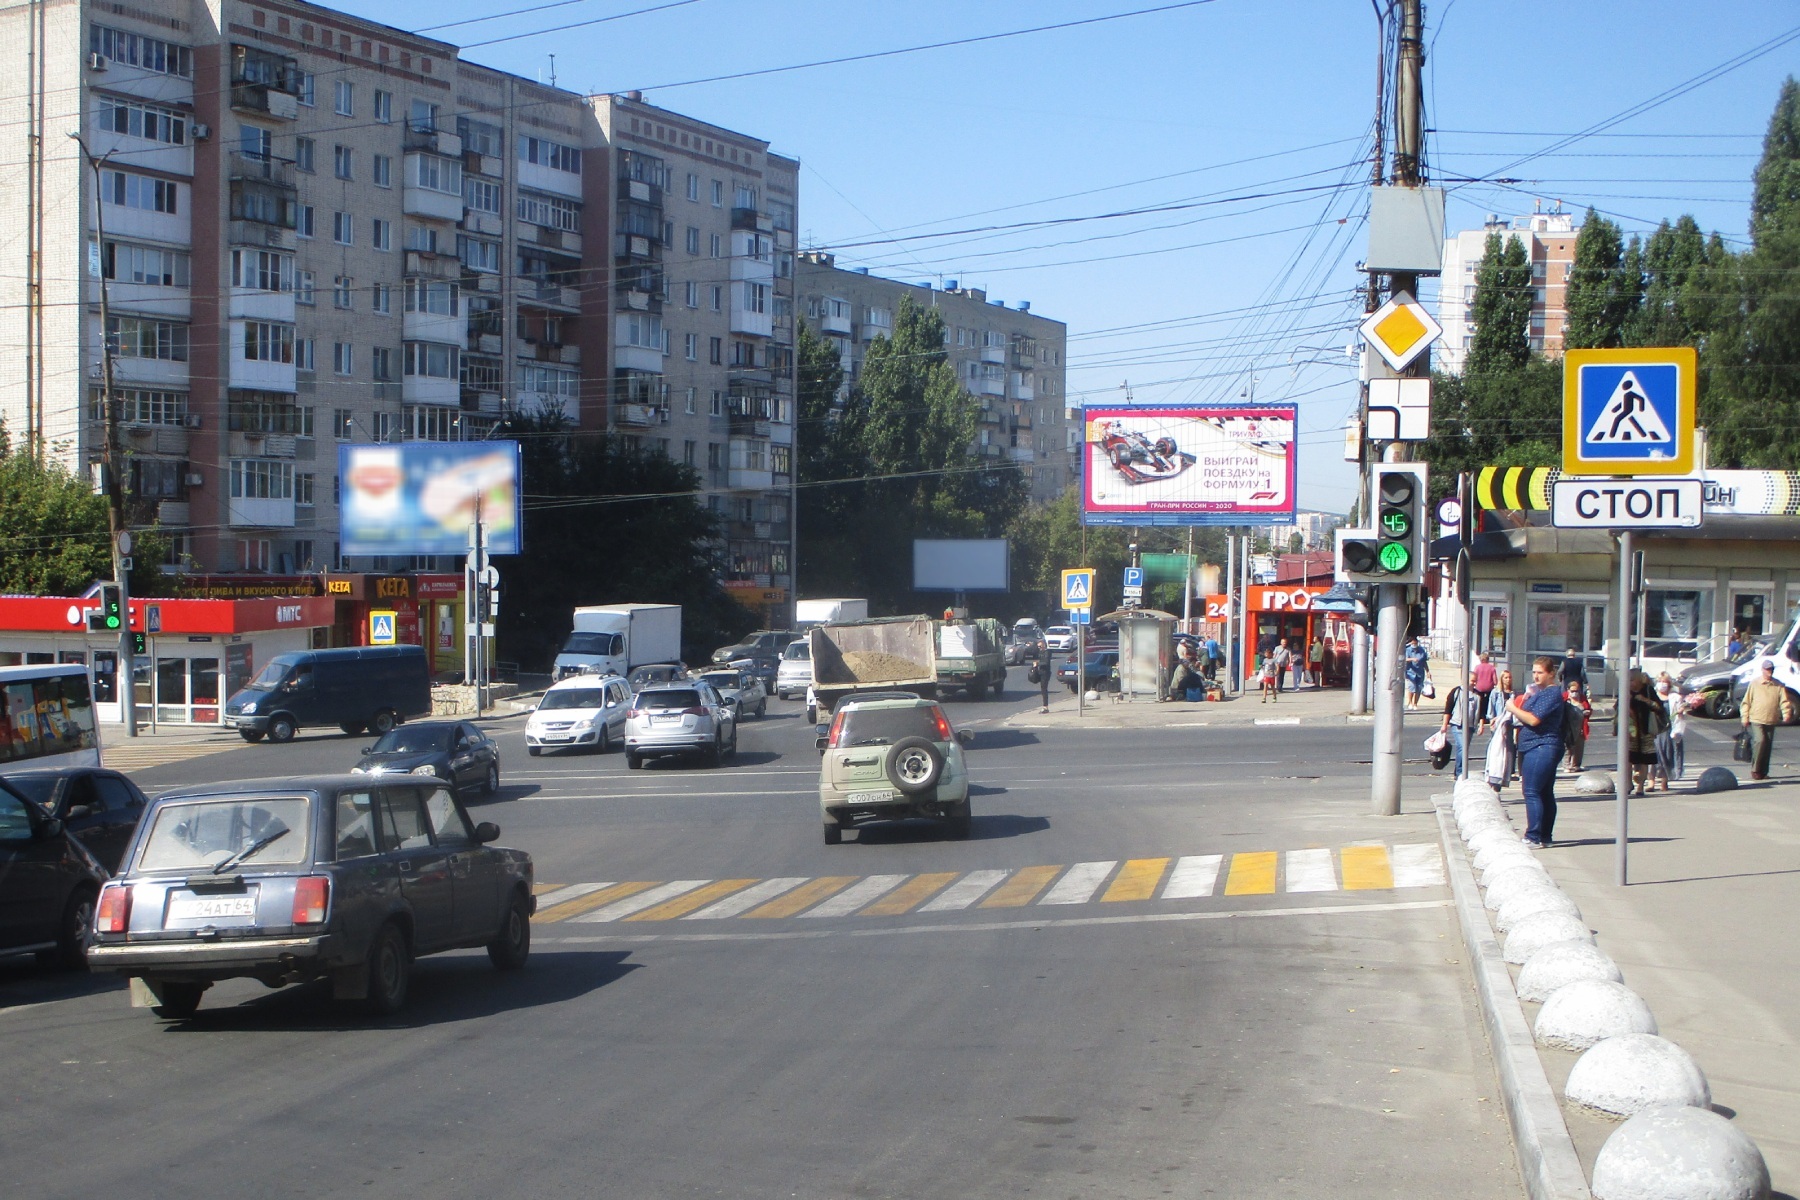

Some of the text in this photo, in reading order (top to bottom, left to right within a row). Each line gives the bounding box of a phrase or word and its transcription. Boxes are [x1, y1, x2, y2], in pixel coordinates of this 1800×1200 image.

[1204, 455, 1258, 466] ВЫИГРАЙ
[1204, 468, 1271, 478] ПОЕЗДКУ на
[1575, 489, 1680, 519] СТОП
[1383, 514, 1406, 532] 45
[1128, 570, 1139, 584] P
[211, 586, 234, 596] ПИВА
[235, 586, 242, 596] И
[244, 586, 287, 596] ВКУСНОГО
[294, 586, 316, 595] ПИВУ
[329, 581, 352, 593] КЕГА
[376, 577, 410, 598] КЕГА
[111, 603, 118, 612] 5
[282, 605, 302, 622] МТС
